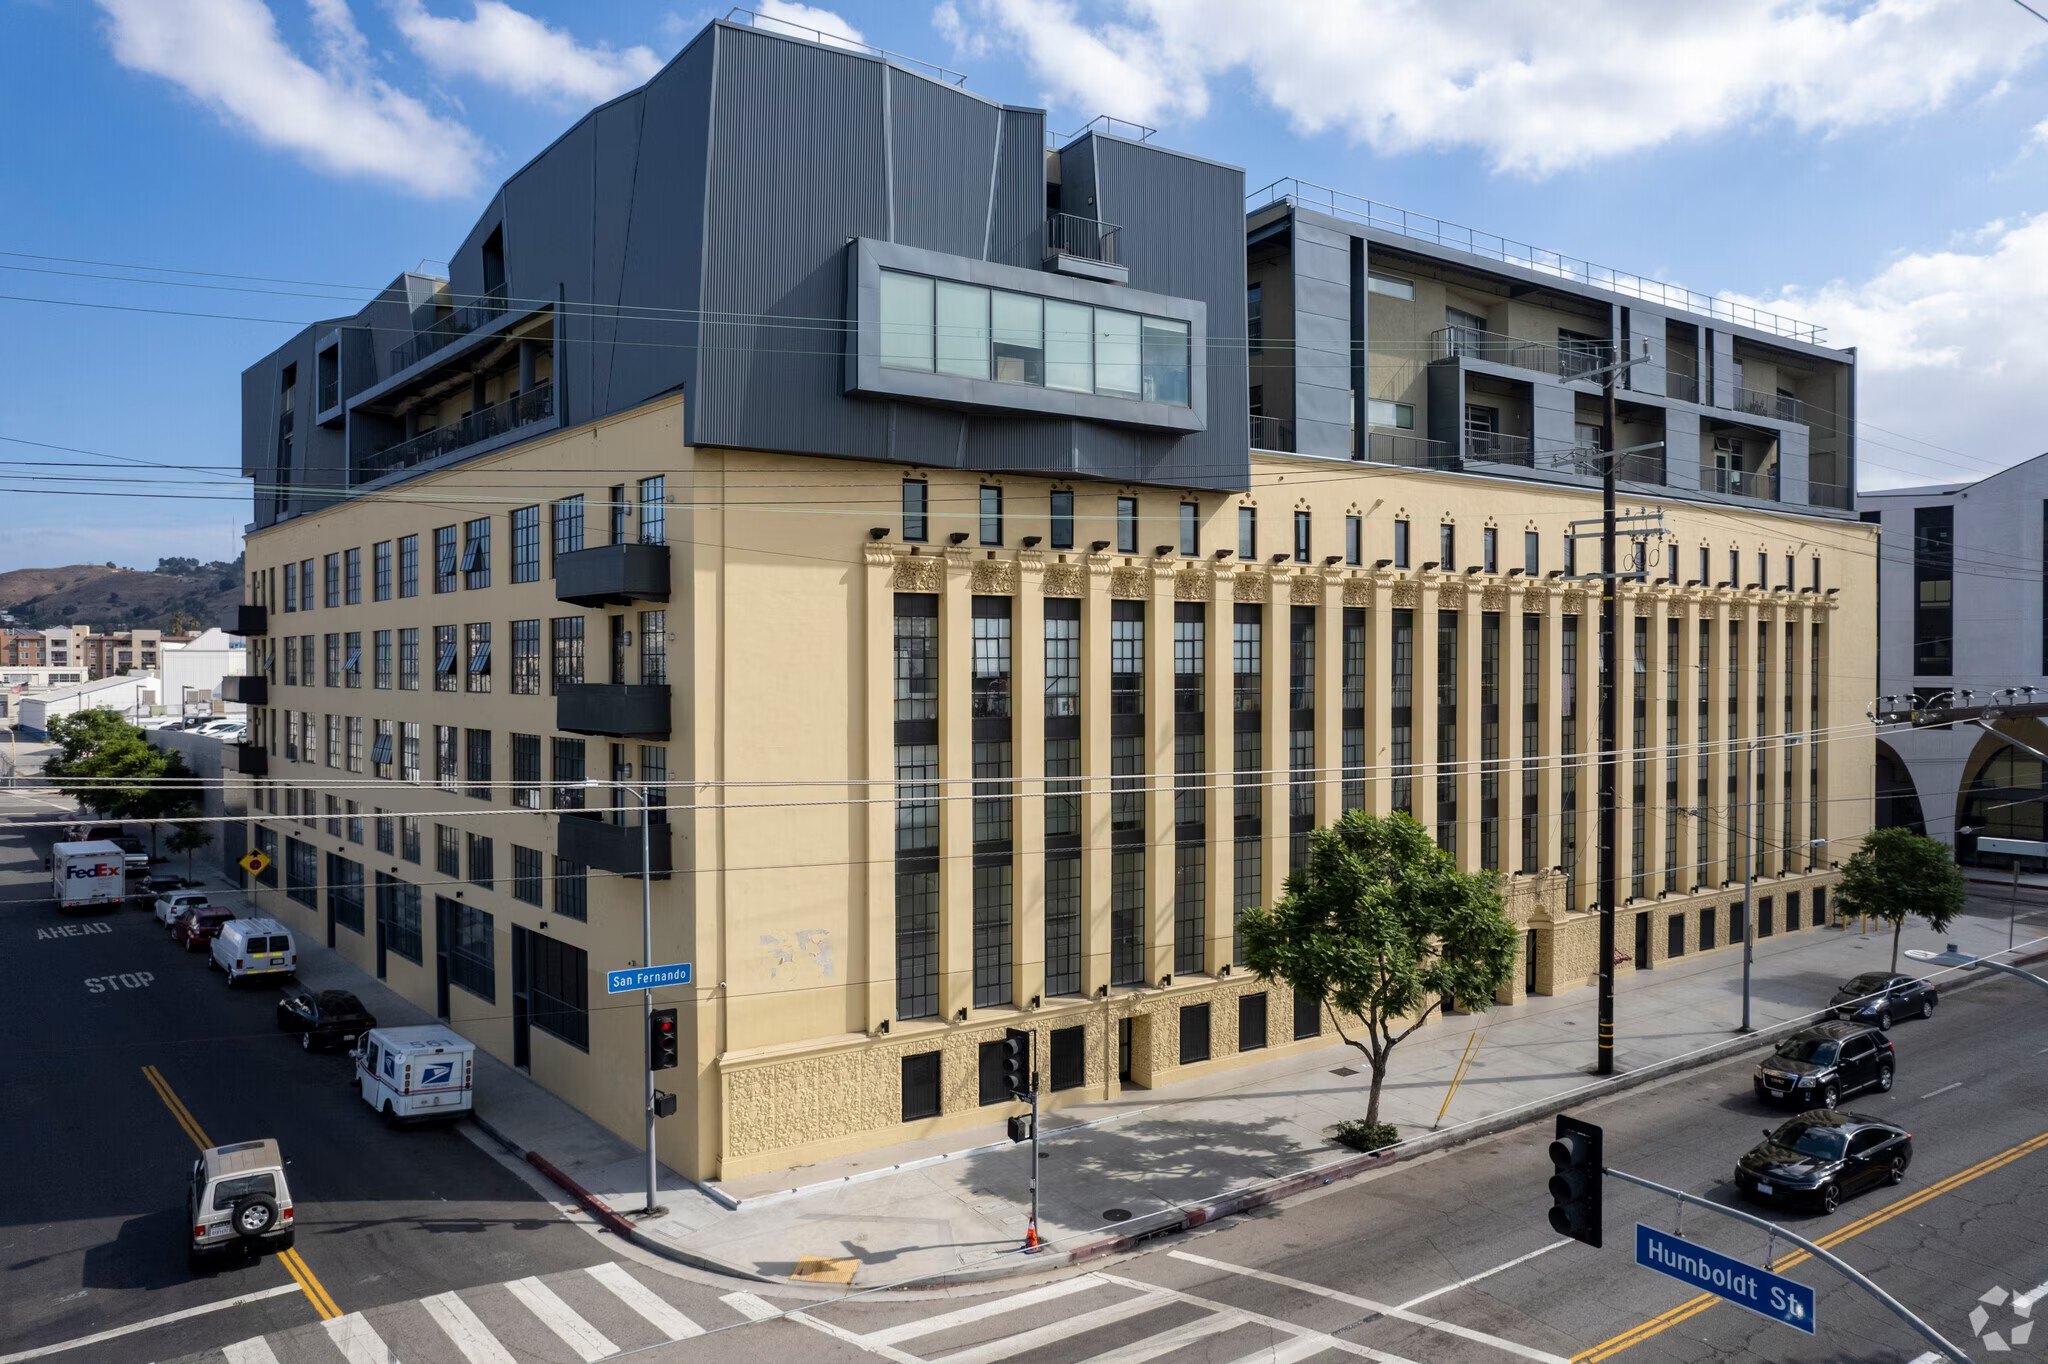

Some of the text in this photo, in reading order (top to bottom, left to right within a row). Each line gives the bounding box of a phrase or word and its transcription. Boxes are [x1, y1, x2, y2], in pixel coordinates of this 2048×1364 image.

[67, 863, 120, 879] FedEx
[36, 922, 113, 940] AHEAD
[84, 971, 155, 993] STOP
[613, 969, 686, 987] San Fernando
[1649, 1238, 1799, 1316] Humboldt St
